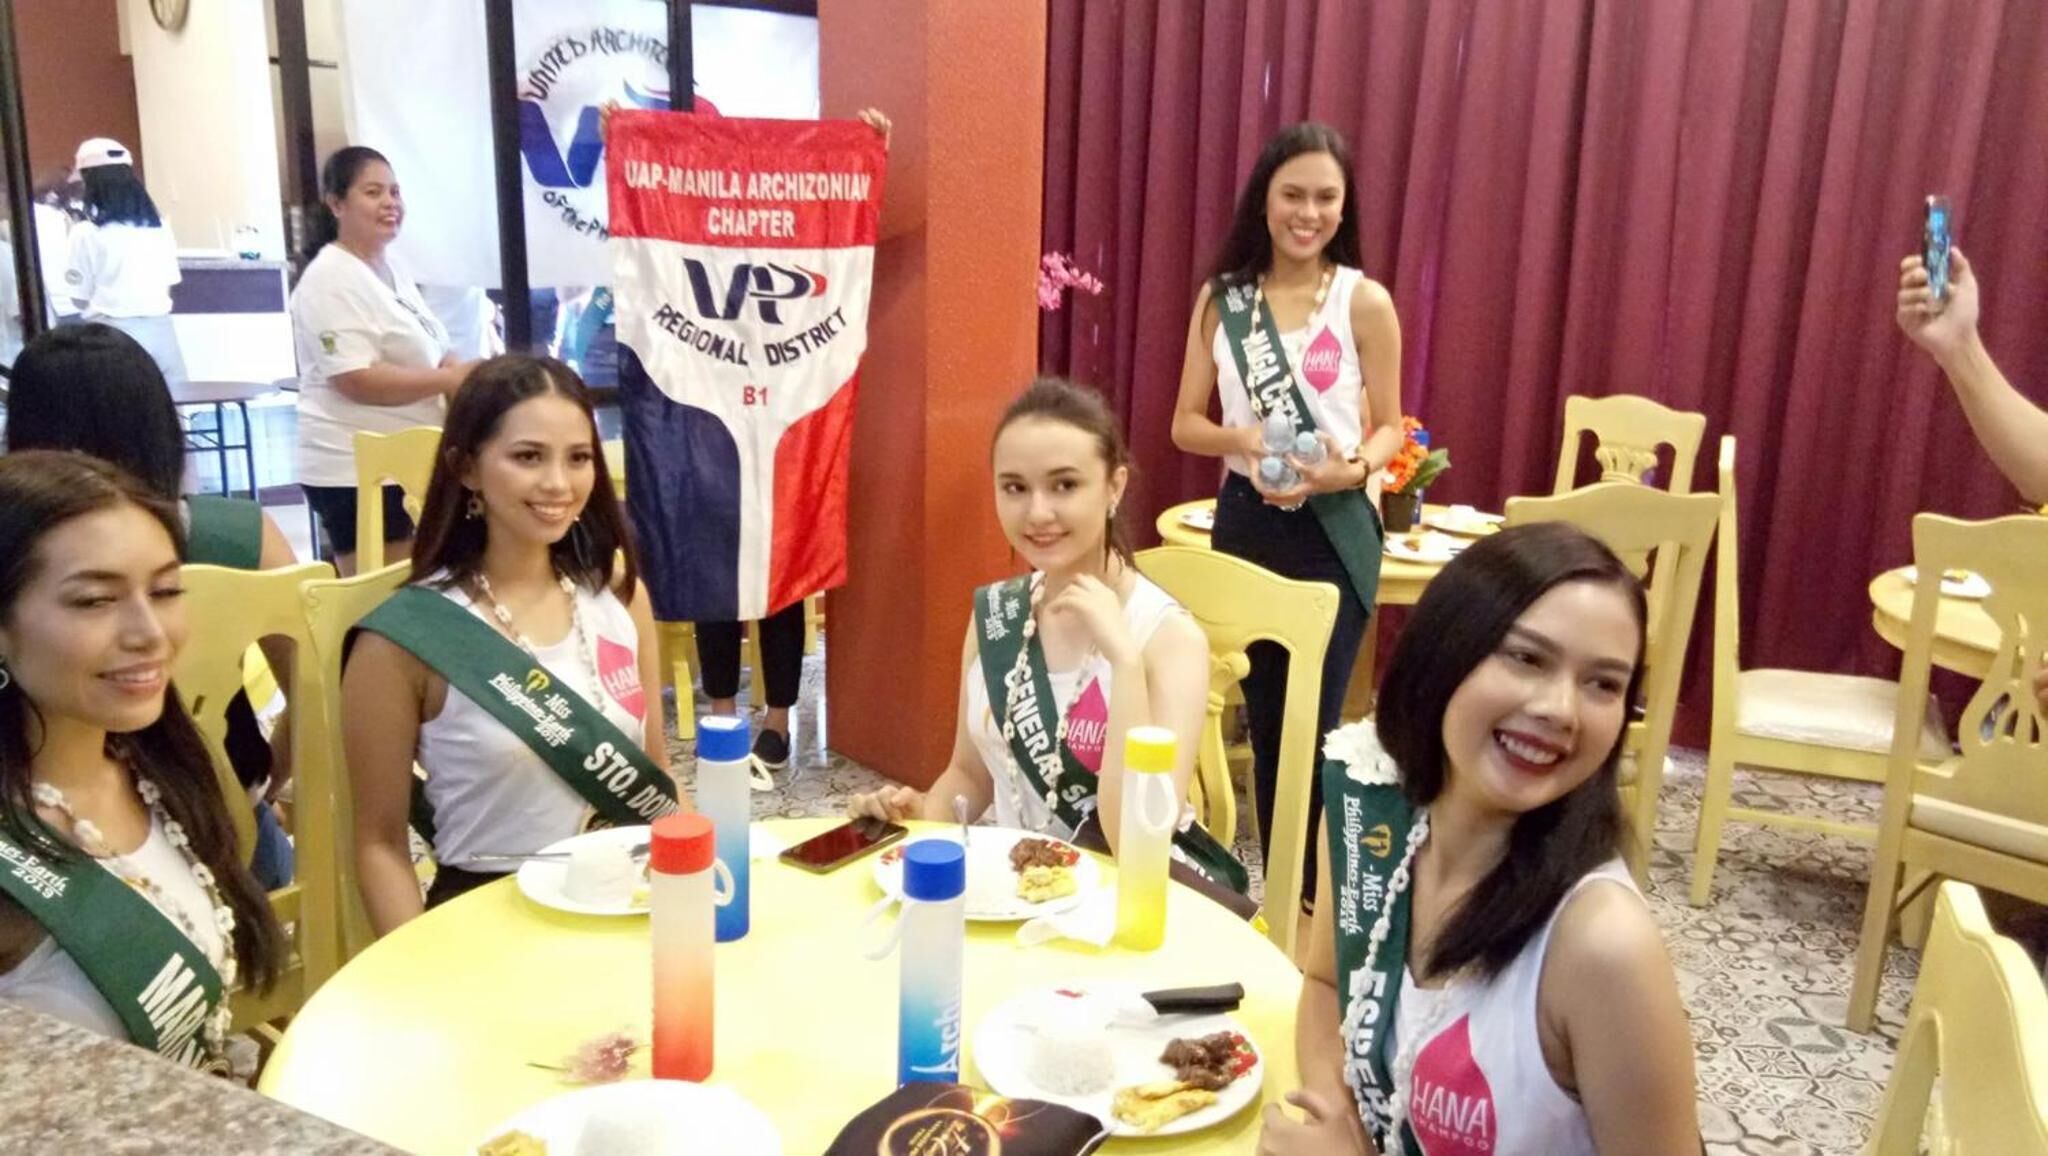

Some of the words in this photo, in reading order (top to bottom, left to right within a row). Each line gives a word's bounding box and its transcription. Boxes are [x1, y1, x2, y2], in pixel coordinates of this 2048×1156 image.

[624, 159, 742, 199] UAP-MANILA
[746, 171, 871, 201] ARCHIZONIAN
[708, 206, 796, 238] CHAPTER
[652, 303, 750, 367] REGIONAL
[764, 306, 848, 367] DISTRICT
[742, 385, 769, 406] B1
[583, 741, 639, 798] STO.
[1343, 792, 1364, 937] Philippines-Earth
[1412, 1075, 1489, 1139] HANA
